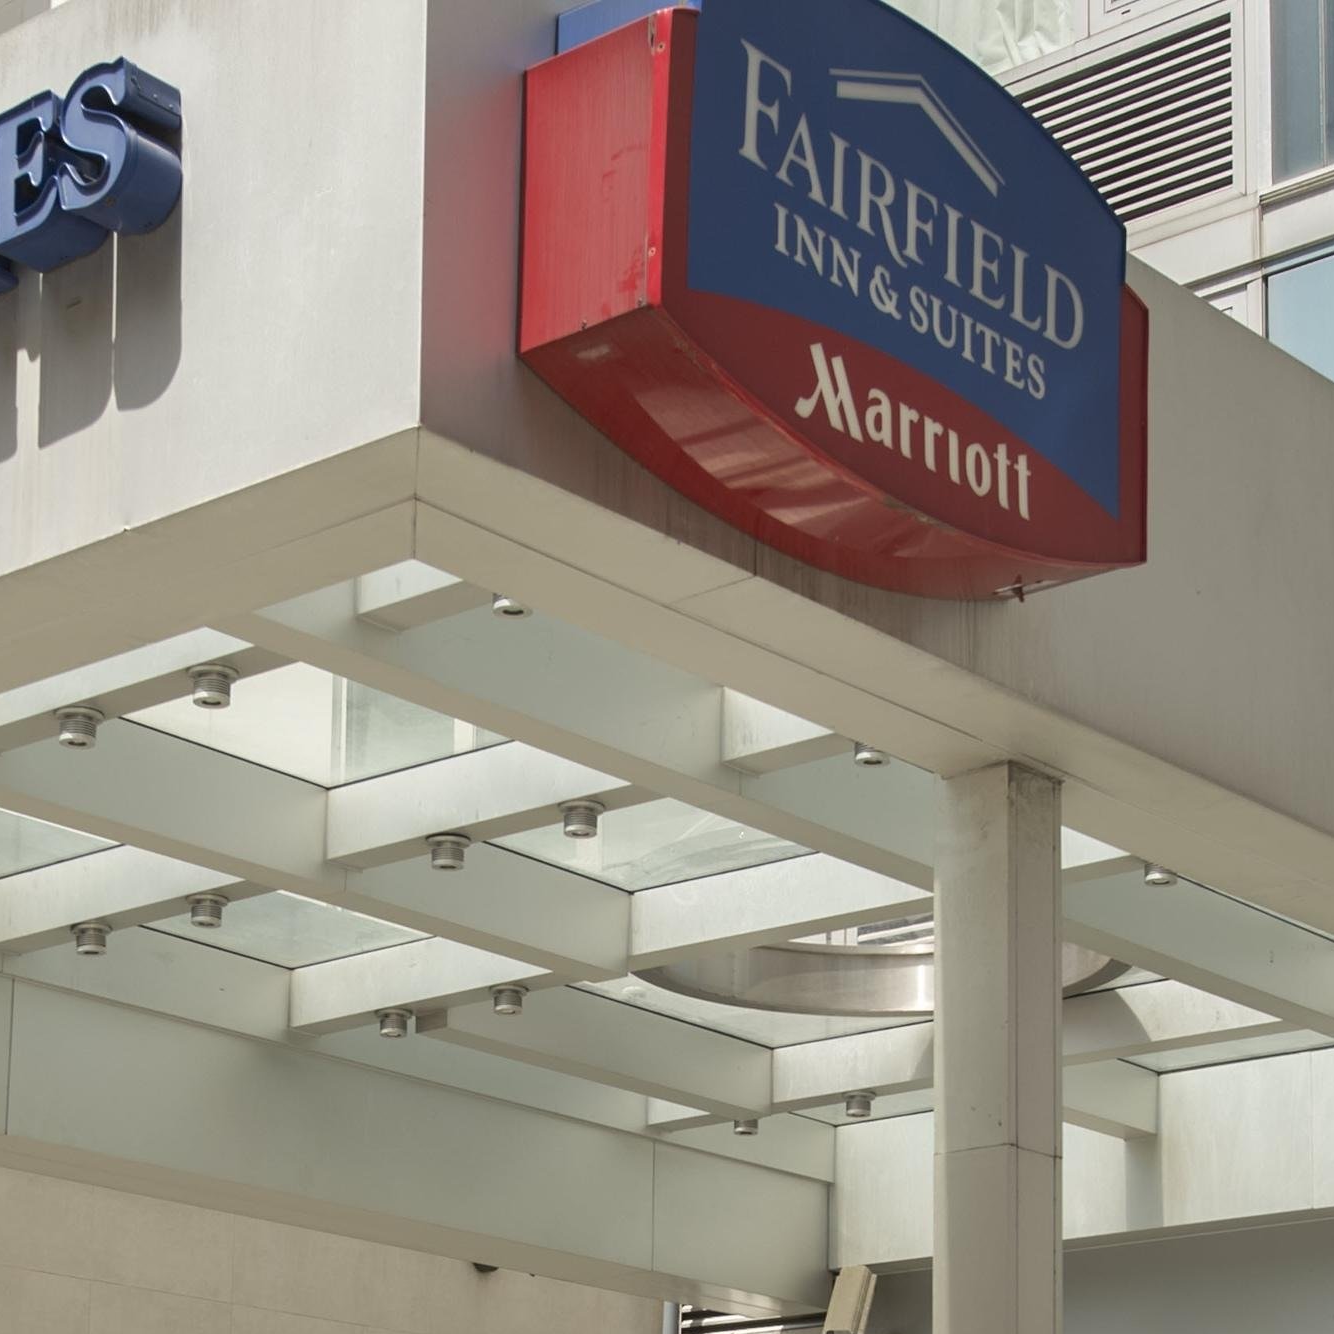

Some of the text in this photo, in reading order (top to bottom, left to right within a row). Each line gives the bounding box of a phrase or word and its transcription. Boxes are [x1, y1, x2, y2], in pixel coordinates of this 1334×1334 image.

[739, 38, 1085, 352] FAIRFIELD
[773, 203, 1047, 401] INN & SUITES
[794, 342, 1032, 521] Marriott
